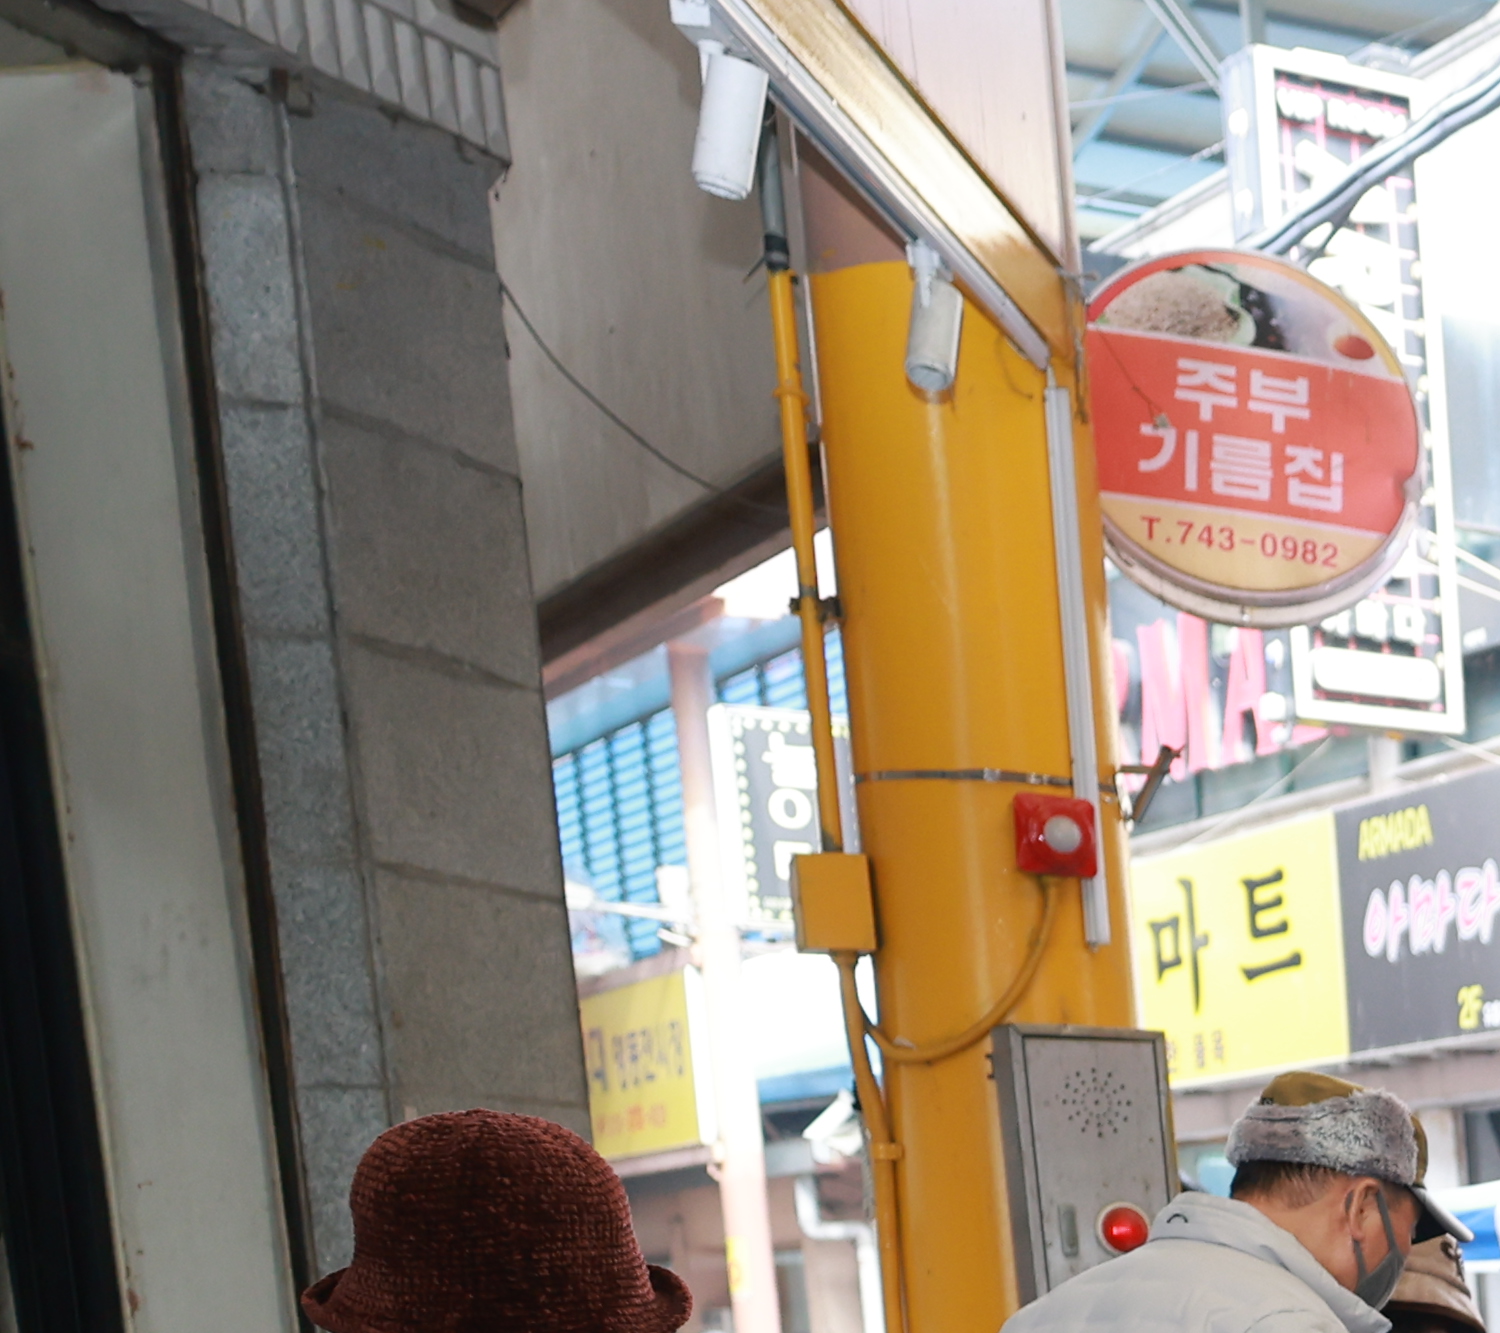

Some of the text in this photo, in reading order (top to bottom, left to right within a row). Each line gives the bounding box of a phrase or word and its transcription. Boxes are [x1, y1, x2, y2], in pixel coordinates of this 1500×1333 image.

[1175, 357, 1311, 434] 주부
[1138, 424, 1345, 512] 기름집
[1141, 515, 1339, 569] T.743-0982
[1147, 868, 1302, 1014] 마트
